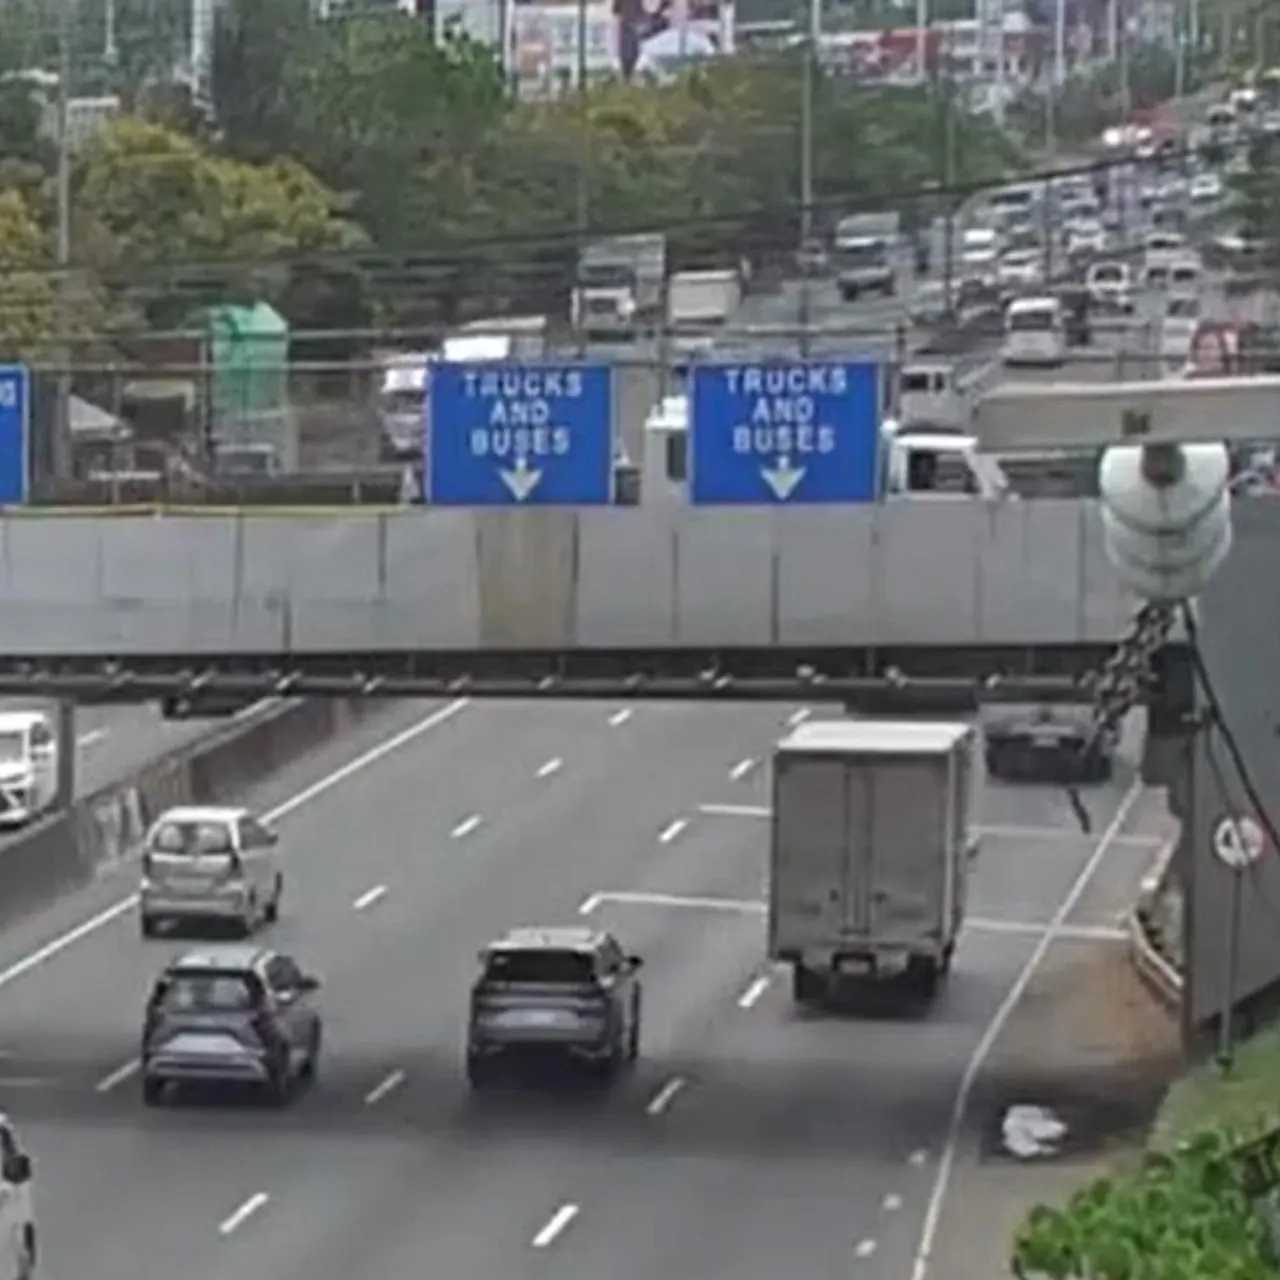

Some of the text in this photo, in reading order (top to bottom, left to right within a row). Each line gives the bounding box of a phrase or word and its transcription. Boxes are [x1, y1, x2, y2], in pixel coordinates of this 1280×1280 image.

[464, 371, 582, 398] TRUCKS
[725, 367, 847, 395] TRUCKS
[488, 401, 548, 425] AND
[751, 398, 813, 422] AND
[471, 428, 570, 455] BUSES
[733, 426, 835, 453] BUSES
